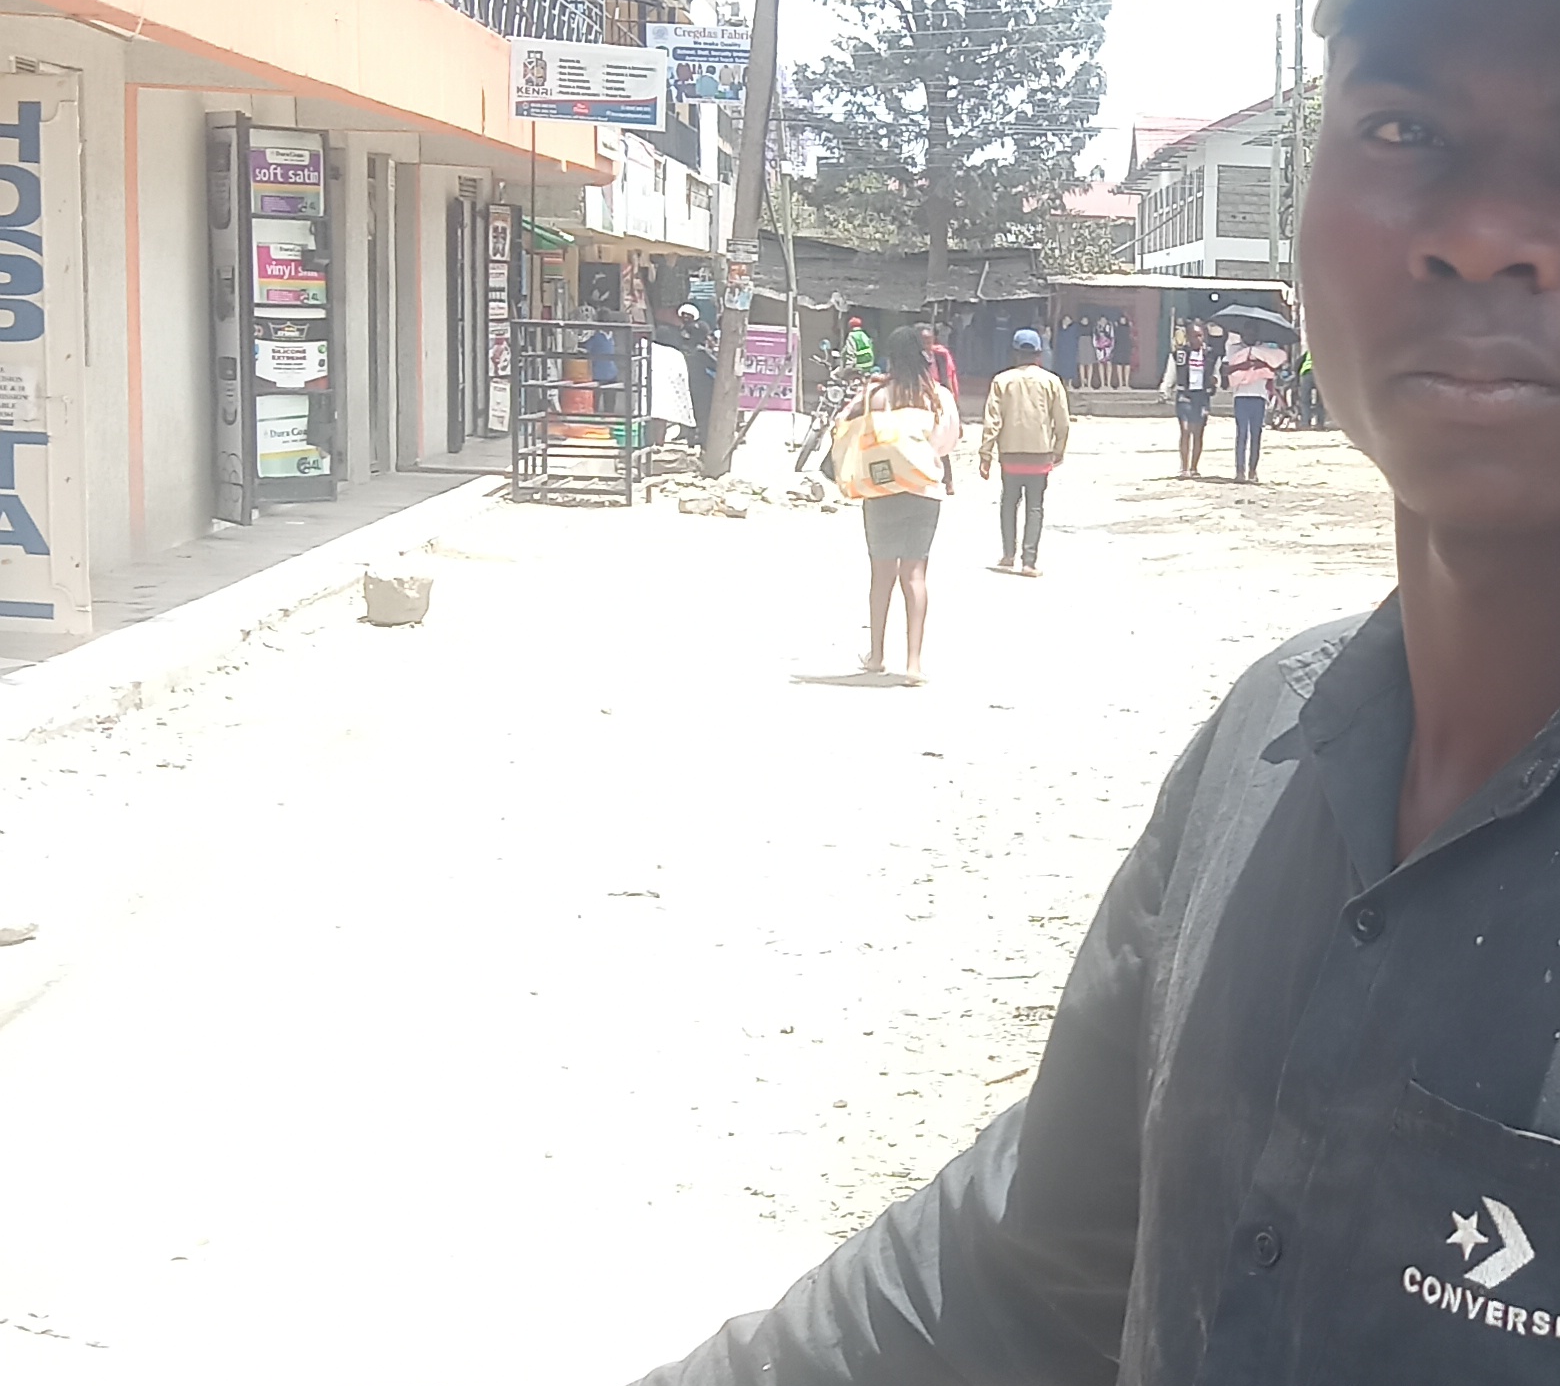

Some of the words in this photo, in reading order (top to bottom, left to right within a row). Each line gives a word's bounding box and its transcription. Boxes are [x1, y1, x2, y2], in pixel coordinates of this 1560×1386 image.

[721, 28, 751, 40] Fabri
[516, 85, 553, 96] KENRI
[255, 164, 283, 182] soft
[288, 166, 319, 183] satin
[266, 261, 295, 280] vinyl
